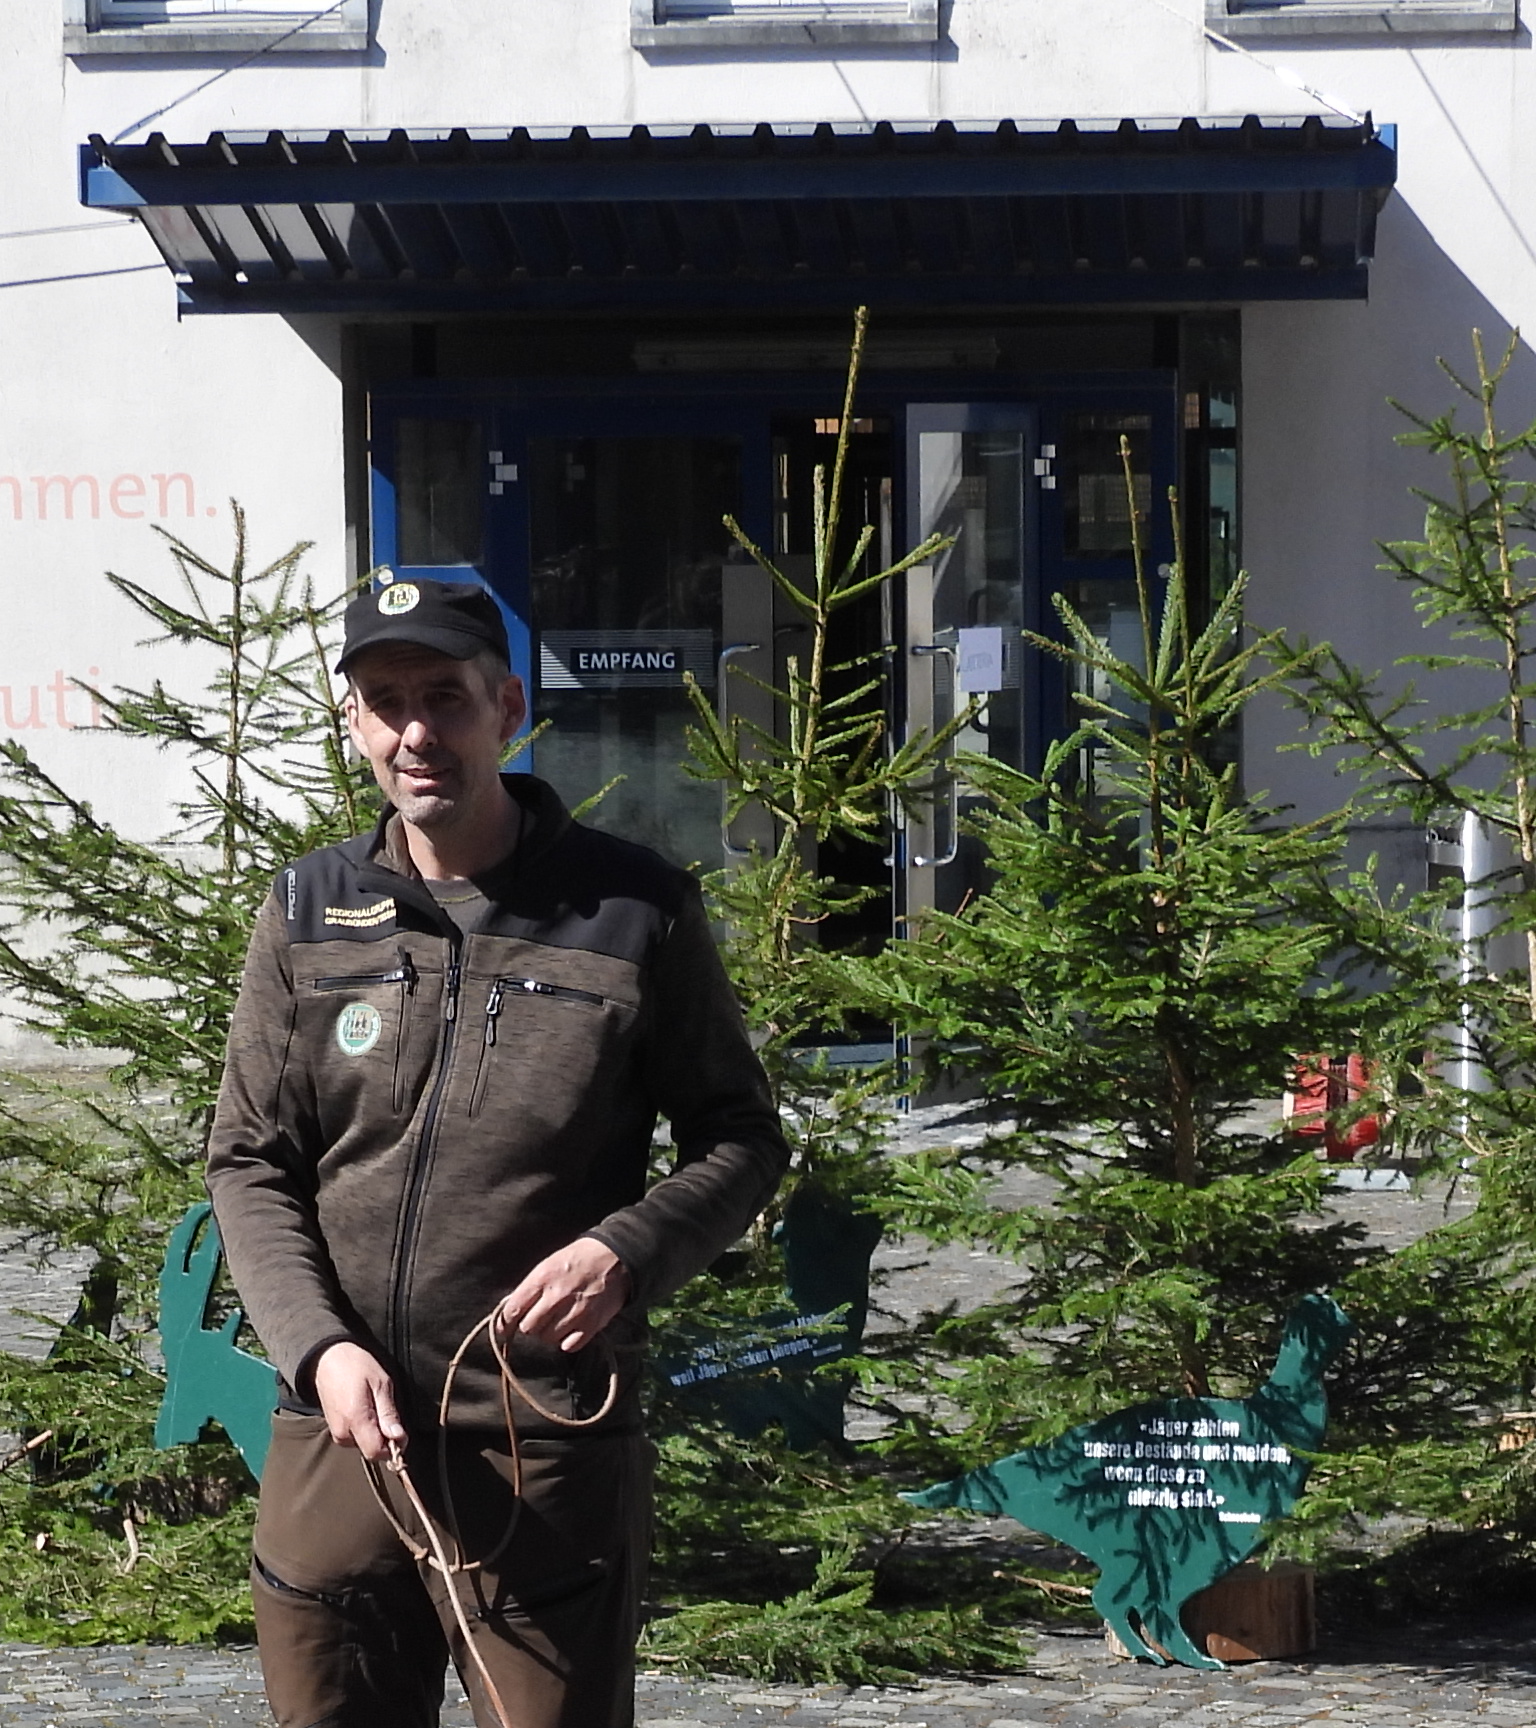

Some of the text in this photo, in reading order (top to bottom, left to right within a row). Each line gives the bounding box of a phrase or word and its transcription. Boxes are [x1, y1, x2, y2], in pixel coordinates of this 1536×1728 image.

[578, 651, 676, 670] EMPFANG
[1191, 1417, 1240, 1438] zählen
[1083, 1440, 1292, 1465] unsere Bestände und melden,
[1104, 1464, 1206, 1484] wenn diese zu
